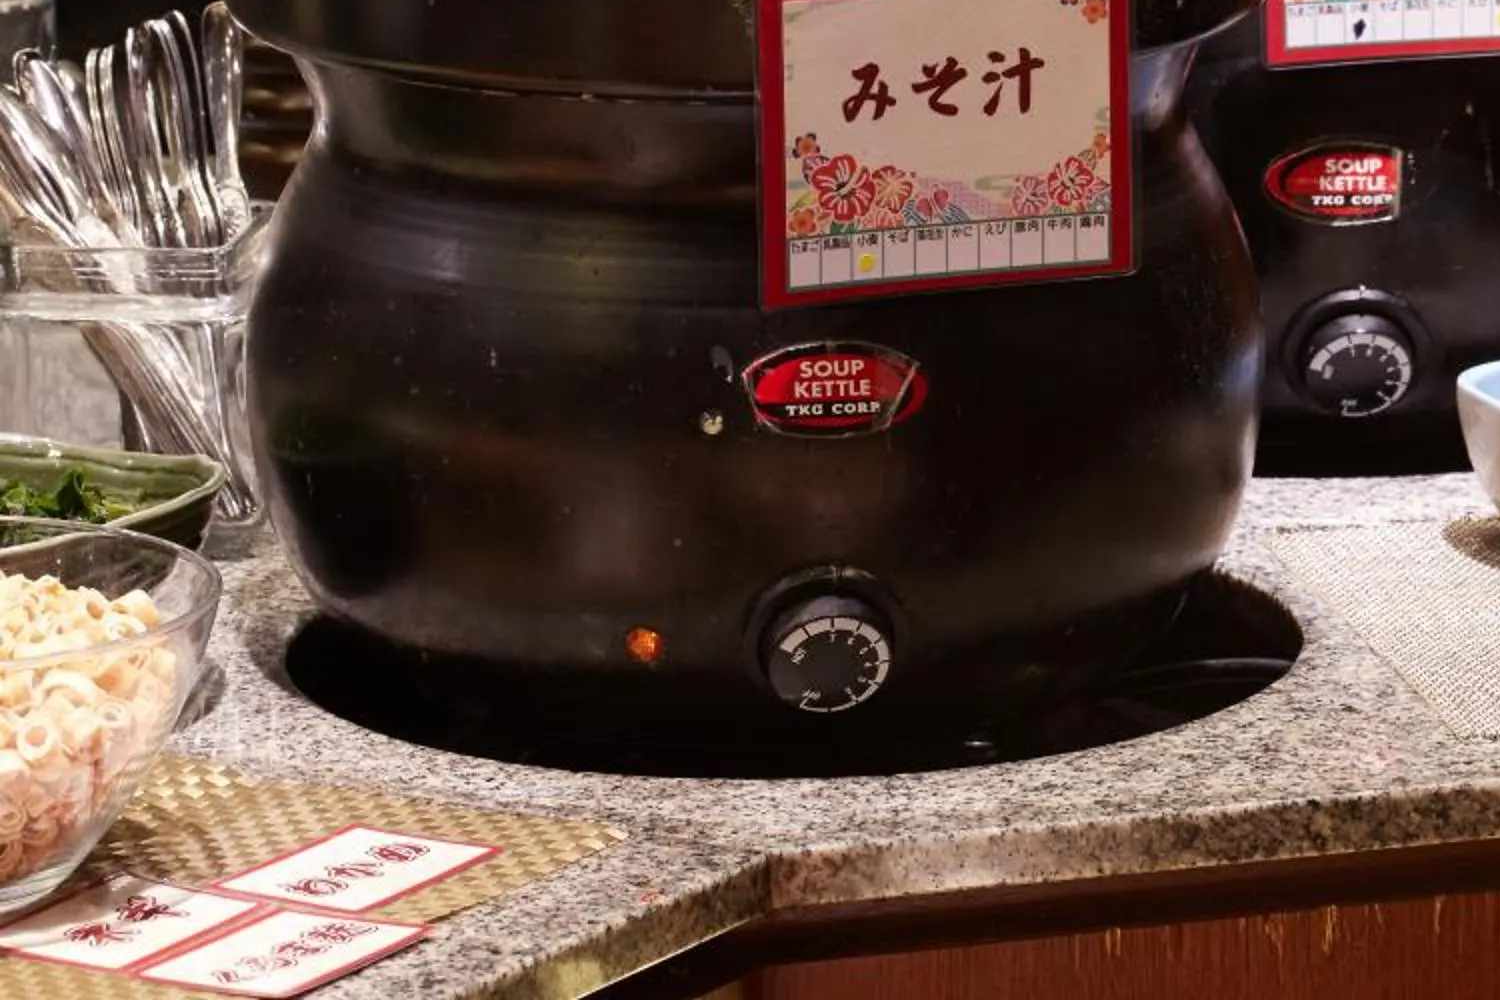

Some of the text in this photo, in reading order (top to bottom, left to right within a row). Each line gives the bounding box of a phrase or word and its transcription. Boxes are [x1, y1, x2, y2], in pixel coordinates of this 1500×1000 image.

[842, 47, 1045, 122] みそ汁
[1325, 158, 1383, 173] SOUP
[1319, 175, 1387, 191] KETTLE
[951, 224, 973, 238] かに
[800, 359, 865, 378] SOUP
[793, 379, 871, 398] KETTLE
[785, 403, 823, 417] TKG
